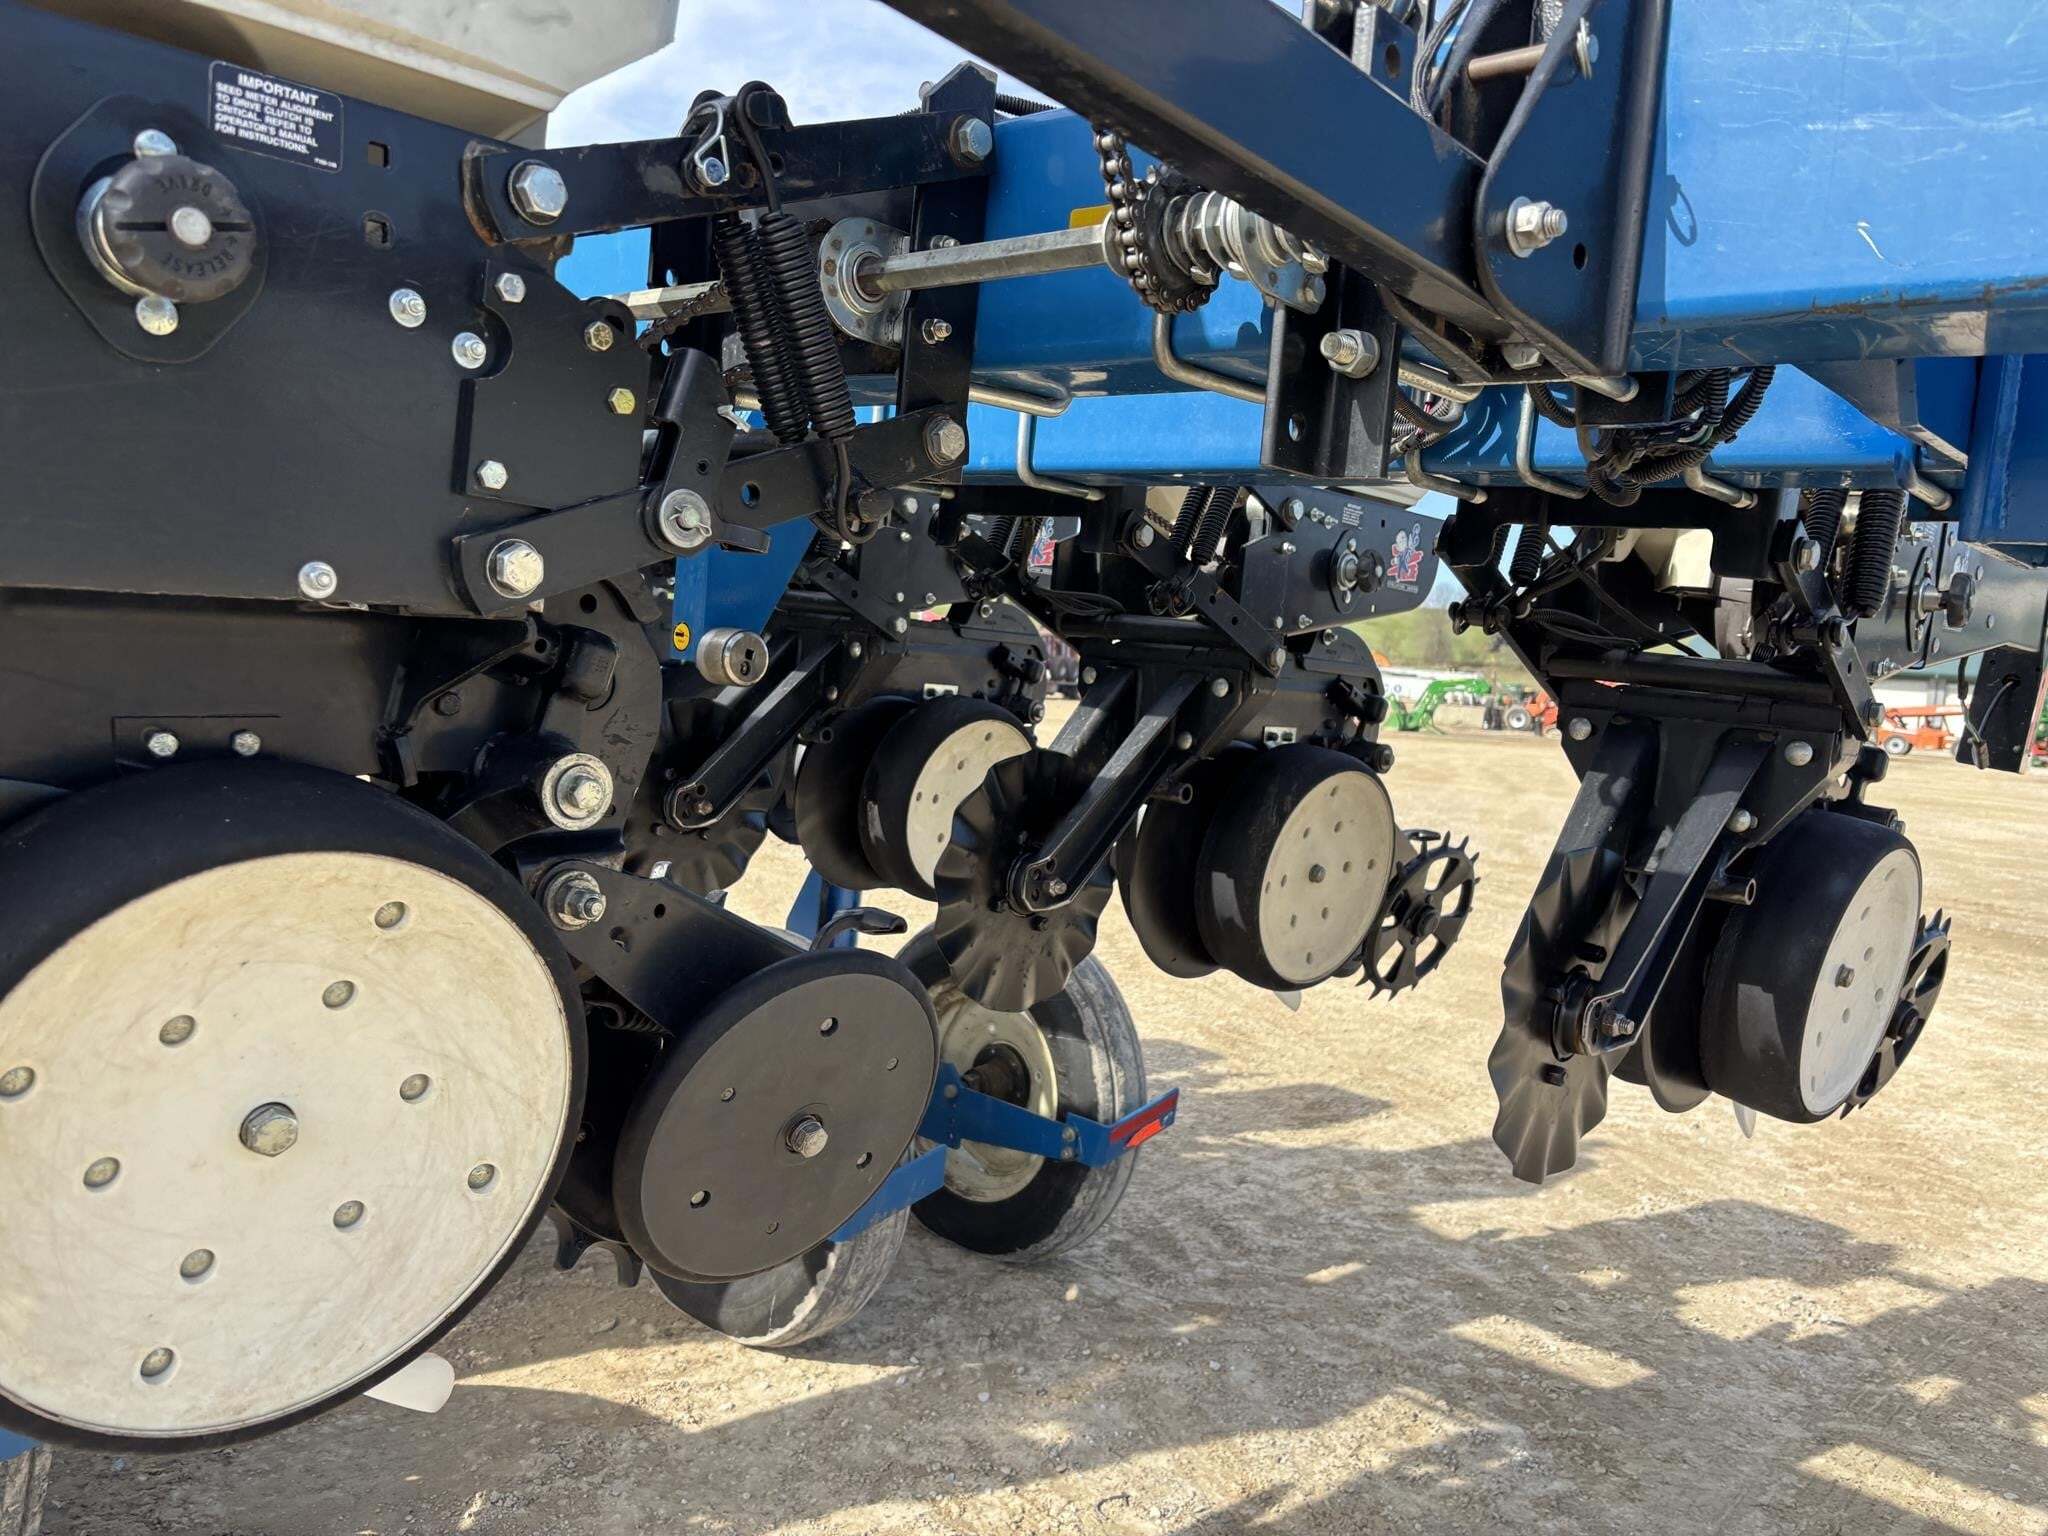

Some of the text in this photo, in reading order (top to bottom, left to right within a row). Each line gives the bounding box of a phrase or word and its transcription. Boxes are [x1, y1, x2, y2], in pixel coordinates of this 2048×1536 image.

[216, 81, 334, 122] SEED METER ALIGNMENT
[237, 73, 319, 106] IMPORTANT
[215, 102, 312, 136] CRITICAL. REFER TO
[216, 92, 314, 127] TO DRIVE CLUTCH IS
[214, 122, 310, 154] FOR INSTRUCTIONS.
[215, 112, 318, 148] OPERATOR'S MANUAL
